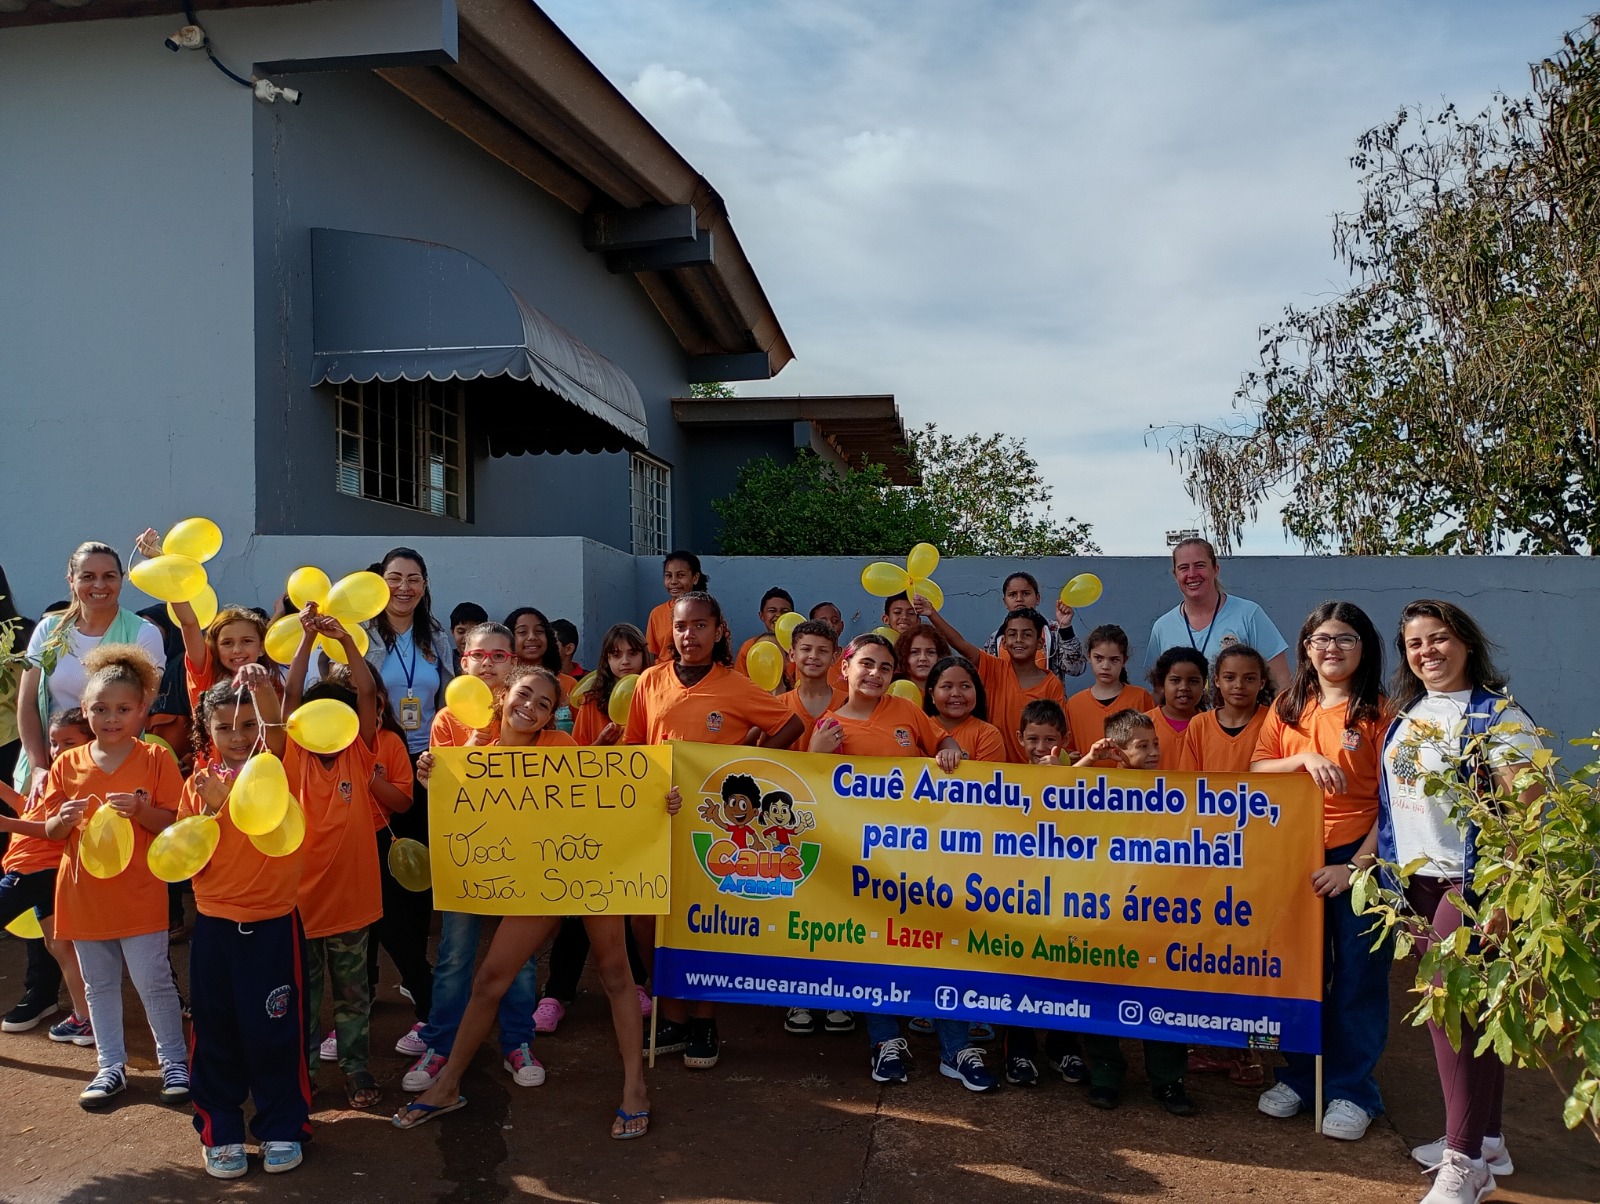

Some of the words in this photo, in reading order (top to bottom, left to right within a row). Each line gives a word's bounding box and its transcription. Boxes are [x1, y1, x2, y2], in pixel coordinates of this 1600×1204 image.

[465, 750, 649, 779] SETEMBRO
[453, 784, 637, 813] AMARELO
[832, 763, 905, 799] Cauê
[913, 764, 1031, 815] Arandu,
[1042, 775, 1186, 814] cuidando
[1196, 778, 1280, 829] hoje,
[442, 821, 516, 867] Você
[532, 832, 603, 862] não
[707, 840, 804, 880] Cauê
[861, 823, 929, 861] para
[940, 829, 982, 854] um
[992, 821, 1099, 861] melhor
[1108, 828, 1244, 868] amanhã!
[718, 874, 795, 897] Arandu
[852, 865, 953, 914] Projeto
[965, 873, 1050, 916] Social
[1063, 890, 1111, 920] nas
[1122, 885, 1202, 925] áreas
[1214, 886, 1252, 926] de
[687, 903, 760, 937] Cultura
[787, 911, 866, 952] Esporte
[886, 918, 943, 949] Lazer
[967, 928, 1024, 959] Meio
[1031, 933, 1140, 969] Ambiente
[1165, 942, 1282, 978] Cidadania
[685, 972, 911, 1006] www.cauearandu.org.br
[963, 989, 1012, 1011] Cauê
[1017, 994, 1090, 1019] Arandu
[1148, 1005, 1281, 1035] @cauearandu
